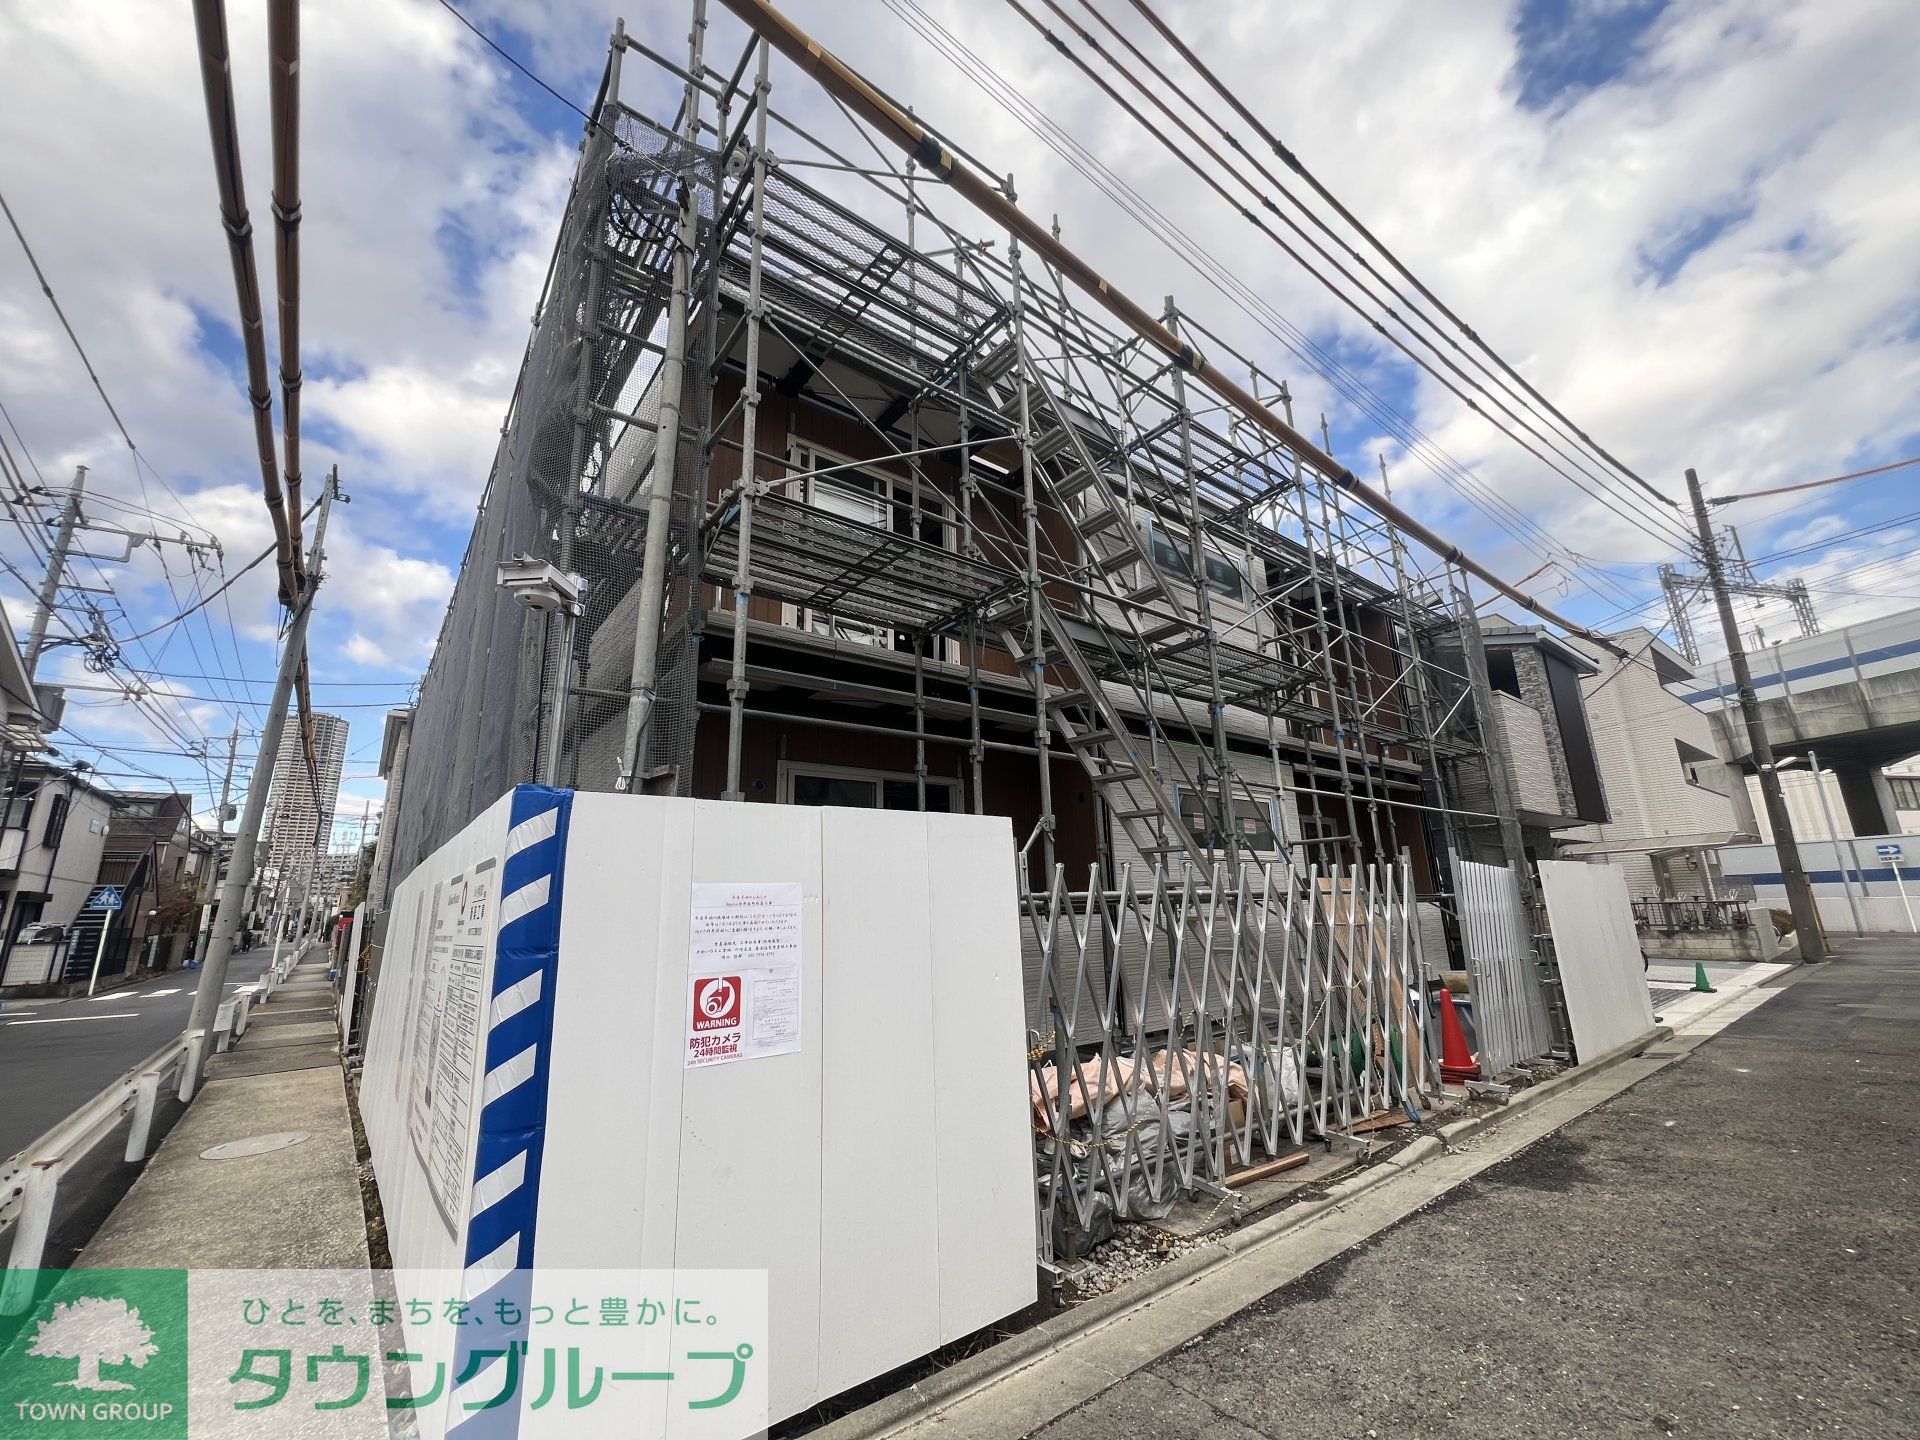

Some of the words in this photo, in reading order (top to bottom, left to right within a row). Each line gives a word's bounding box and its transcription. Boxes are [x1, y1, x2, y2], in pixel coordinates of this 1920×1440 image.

[696, 1017, 737, 1030] WARNING
[689, 1032, 741, 1050] 防犯カメラ
[693, 1043, 738, 1058] 24時間監視
[720, 1053, 743, 1061] CAMERAS
